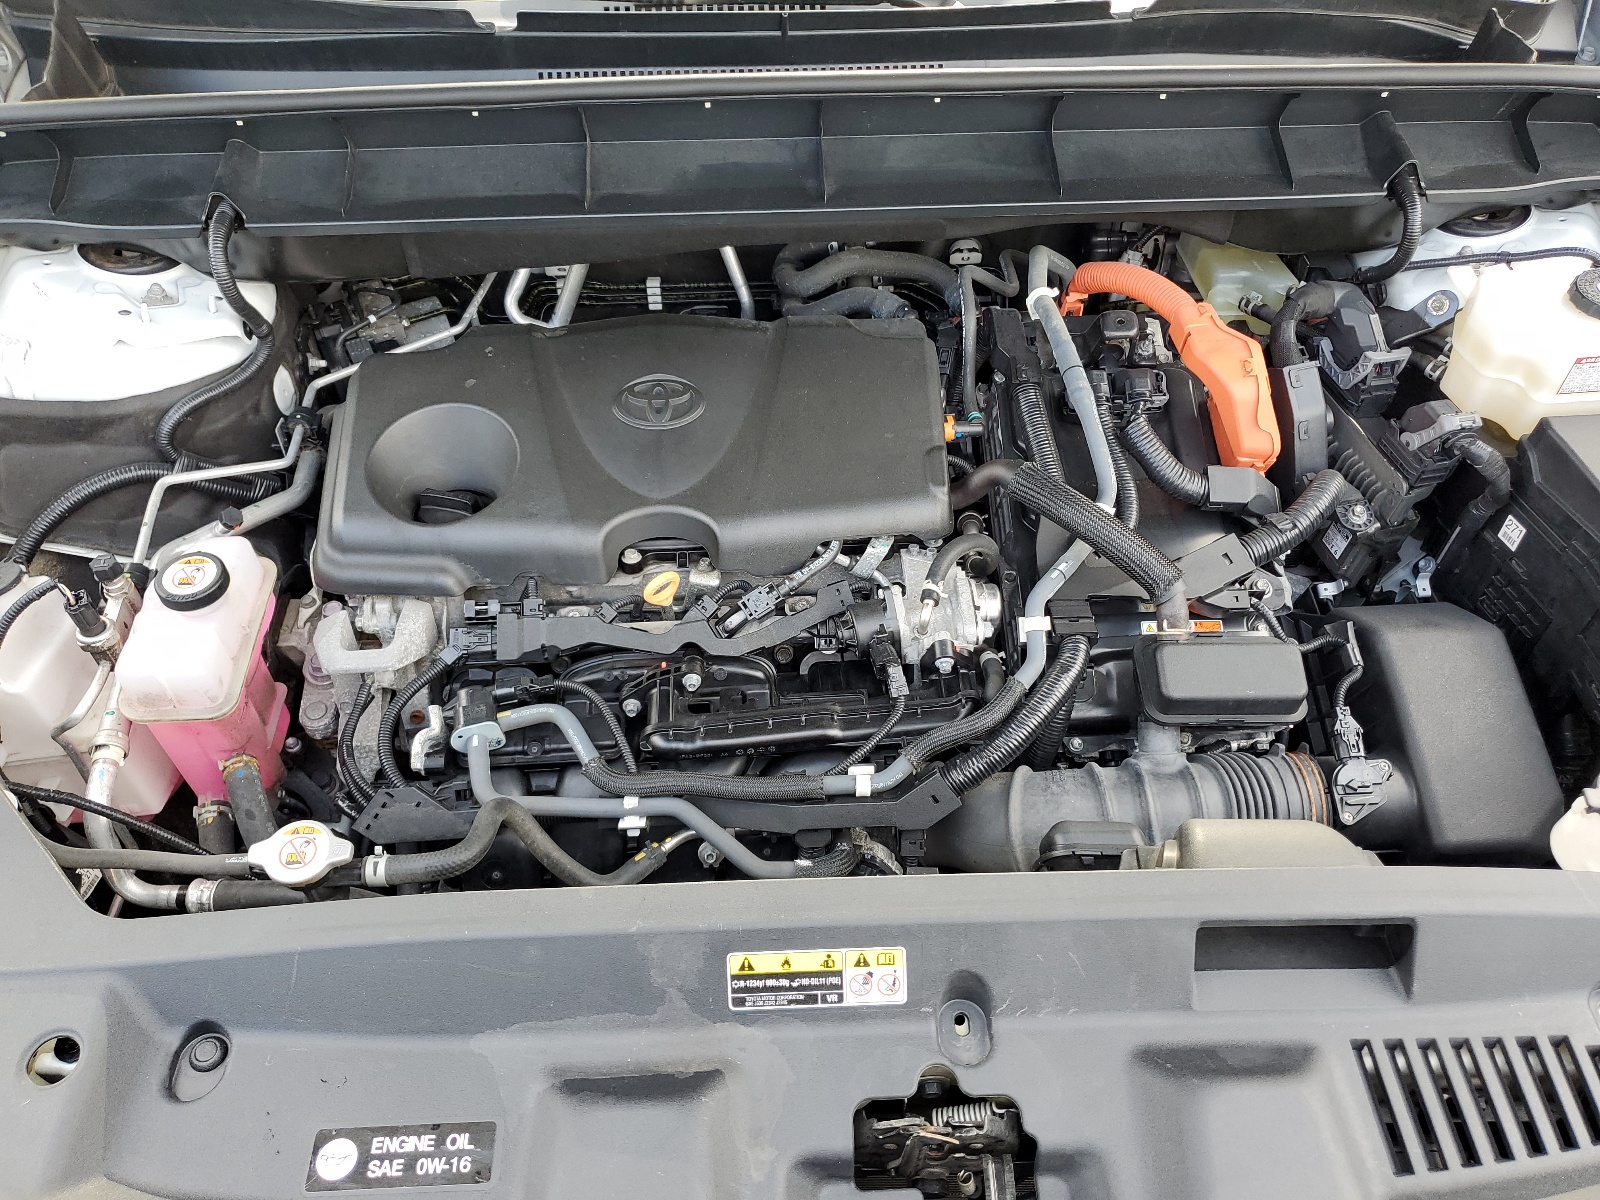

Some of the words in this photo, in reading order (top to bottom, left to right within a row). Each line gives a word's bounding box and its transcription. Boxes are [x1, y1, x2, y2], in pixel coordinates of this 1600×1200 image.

[1504, 518, 1524, 539] 271
[165, 592, 198, 602] DENSO
[739, 979, 765, 989] R-1234yf
[801, 977, 826, 987] ND-OIL11
[826, 976, 841, 986] (POE)
[826, 994, 839, 1003] VR
[371, 1134, 436, 1154] ENGINE
[446, 1132, 475, 1151] OIL
[367, 1158, 404, 1178] SAE
[416, 1156, 472, 1175] 0W-16
